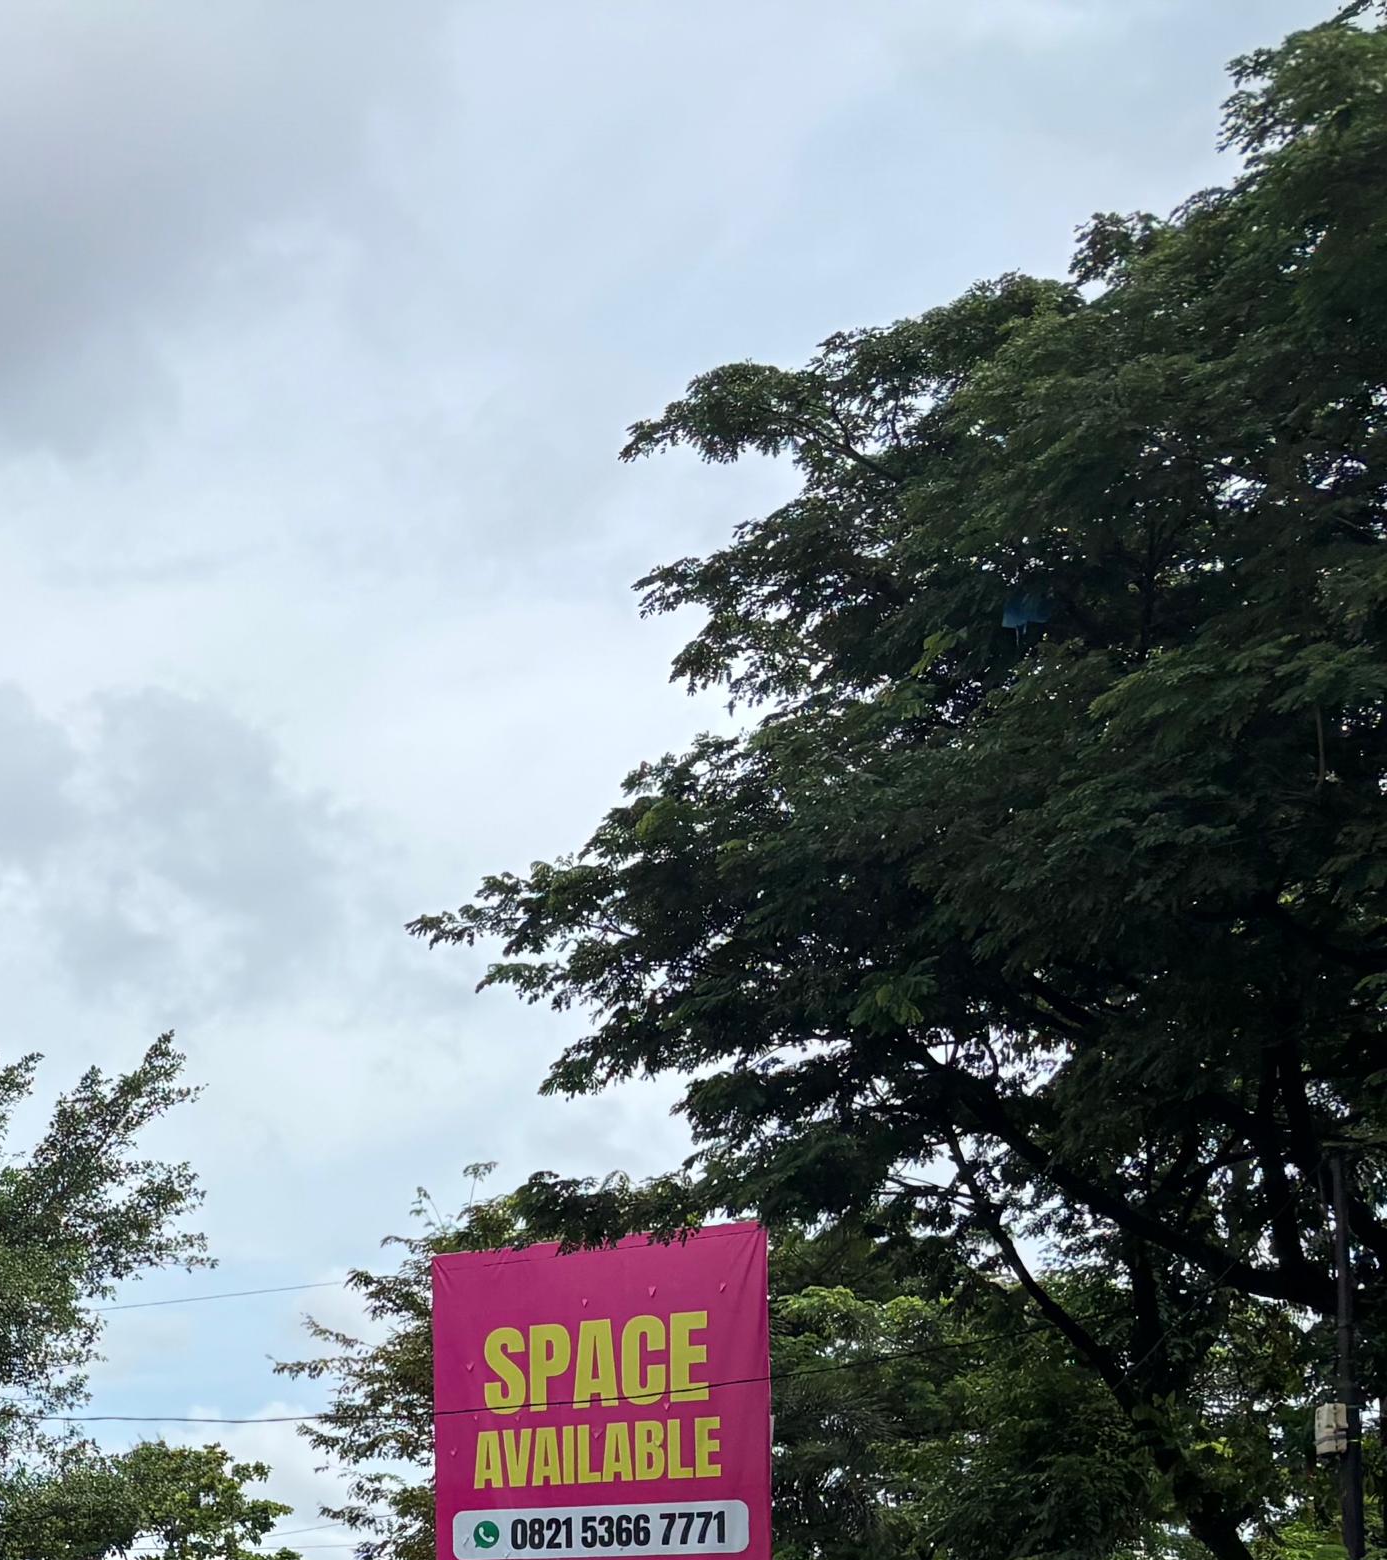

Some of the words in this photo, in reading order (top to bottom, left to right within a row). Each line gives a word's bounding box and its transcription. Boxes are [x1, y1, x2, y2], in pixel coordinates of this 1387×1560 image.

[484, 1311, 710, 1415] SPACE
[474, 1416, 722, 1489] AVAILABLE
[511, 1517, 573, 1550] 0821
[581, 1514, 651, 1547] 5366
[659, 1511, 726, 1546] 7771
